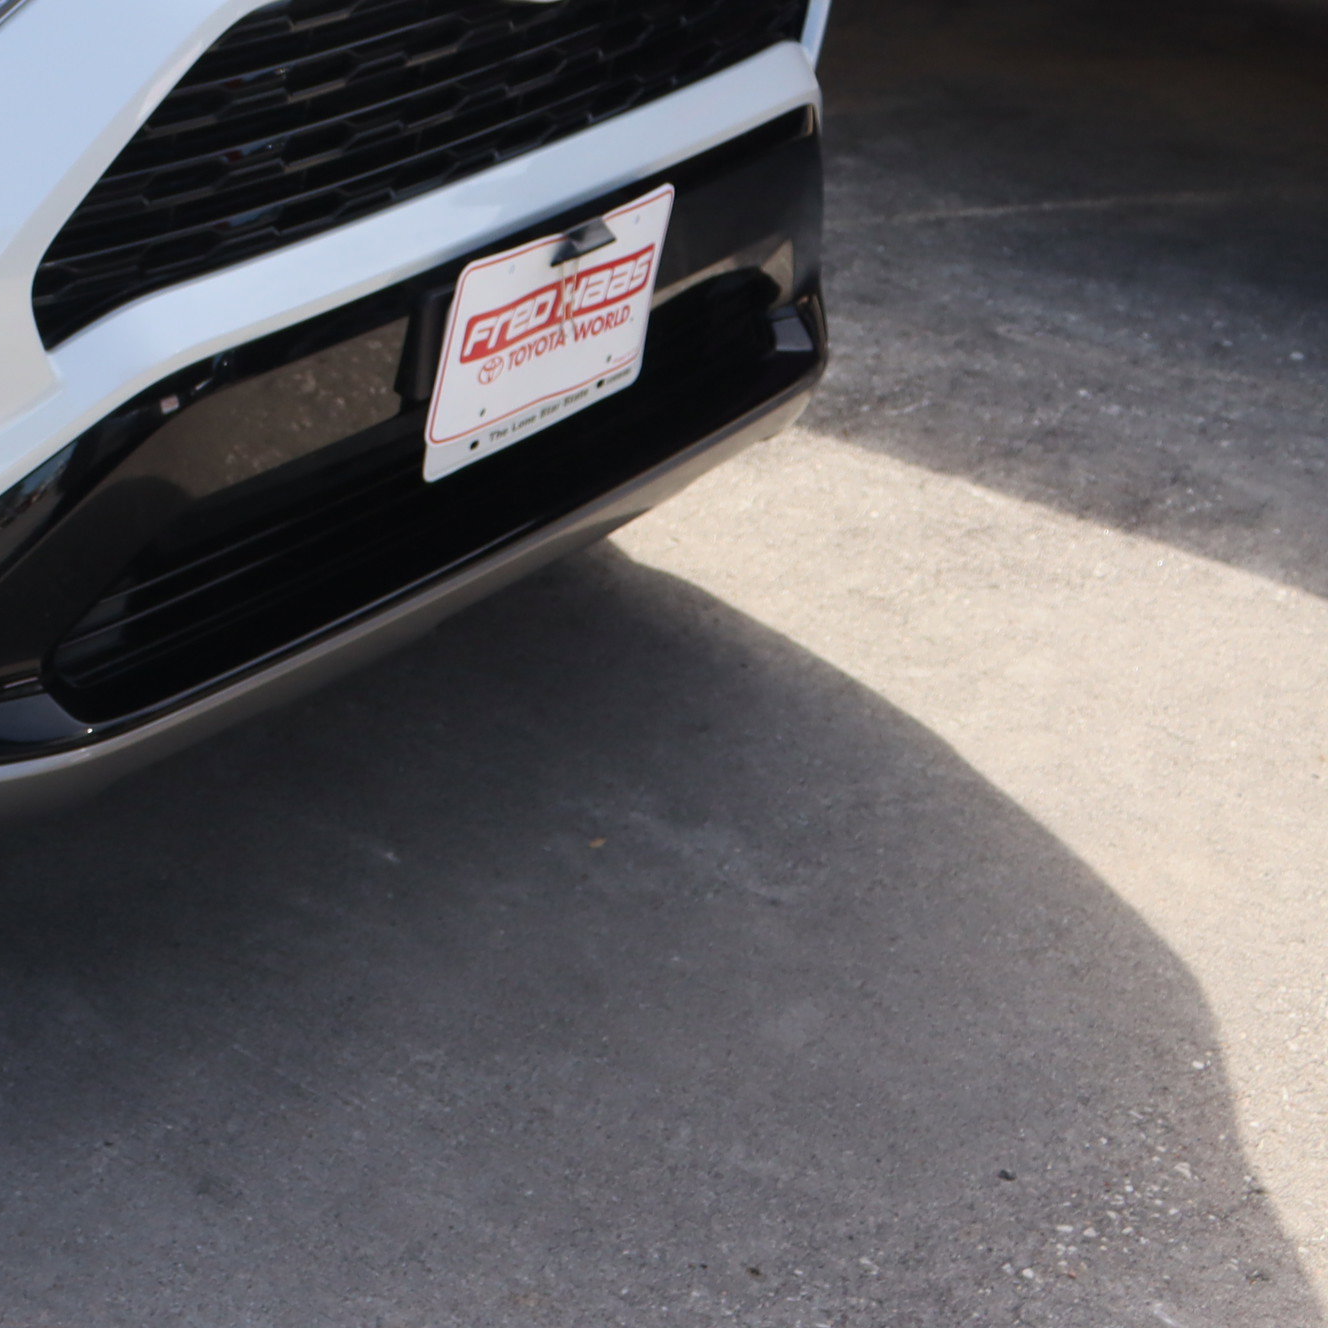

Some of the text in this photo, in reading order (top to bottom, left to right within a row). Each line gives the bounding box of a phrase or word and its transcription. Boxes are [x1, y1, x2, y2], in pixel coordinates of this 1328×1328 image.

[507, 305, 631, 370] TOYOTA WORLD
[489, 427, 507, 442] The
[512, 415, 537, 432] Lone
